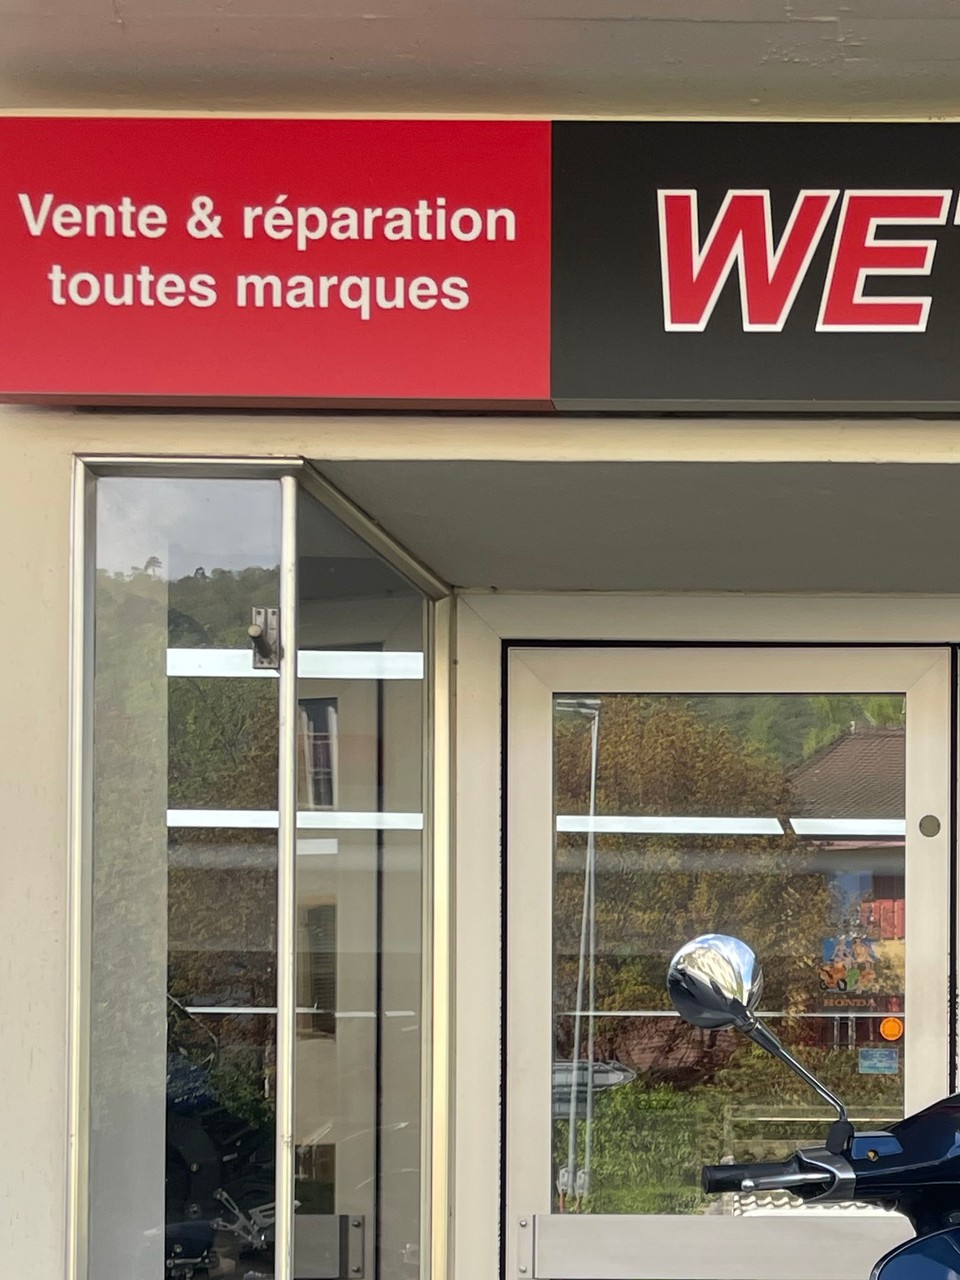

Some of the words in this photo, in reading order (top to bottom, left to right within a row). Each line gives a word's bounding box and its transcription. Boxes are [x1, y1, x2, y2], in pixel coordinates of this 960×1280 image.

[19, 194, 167, 238] Vente
[187, 196, 222, 238] &
[244, 195, 515, 250] réparation
[48, 265, 216, 307] toutes
[237, 275, 469, 320] marques
[823, 999, 876, 1007] HONDA
